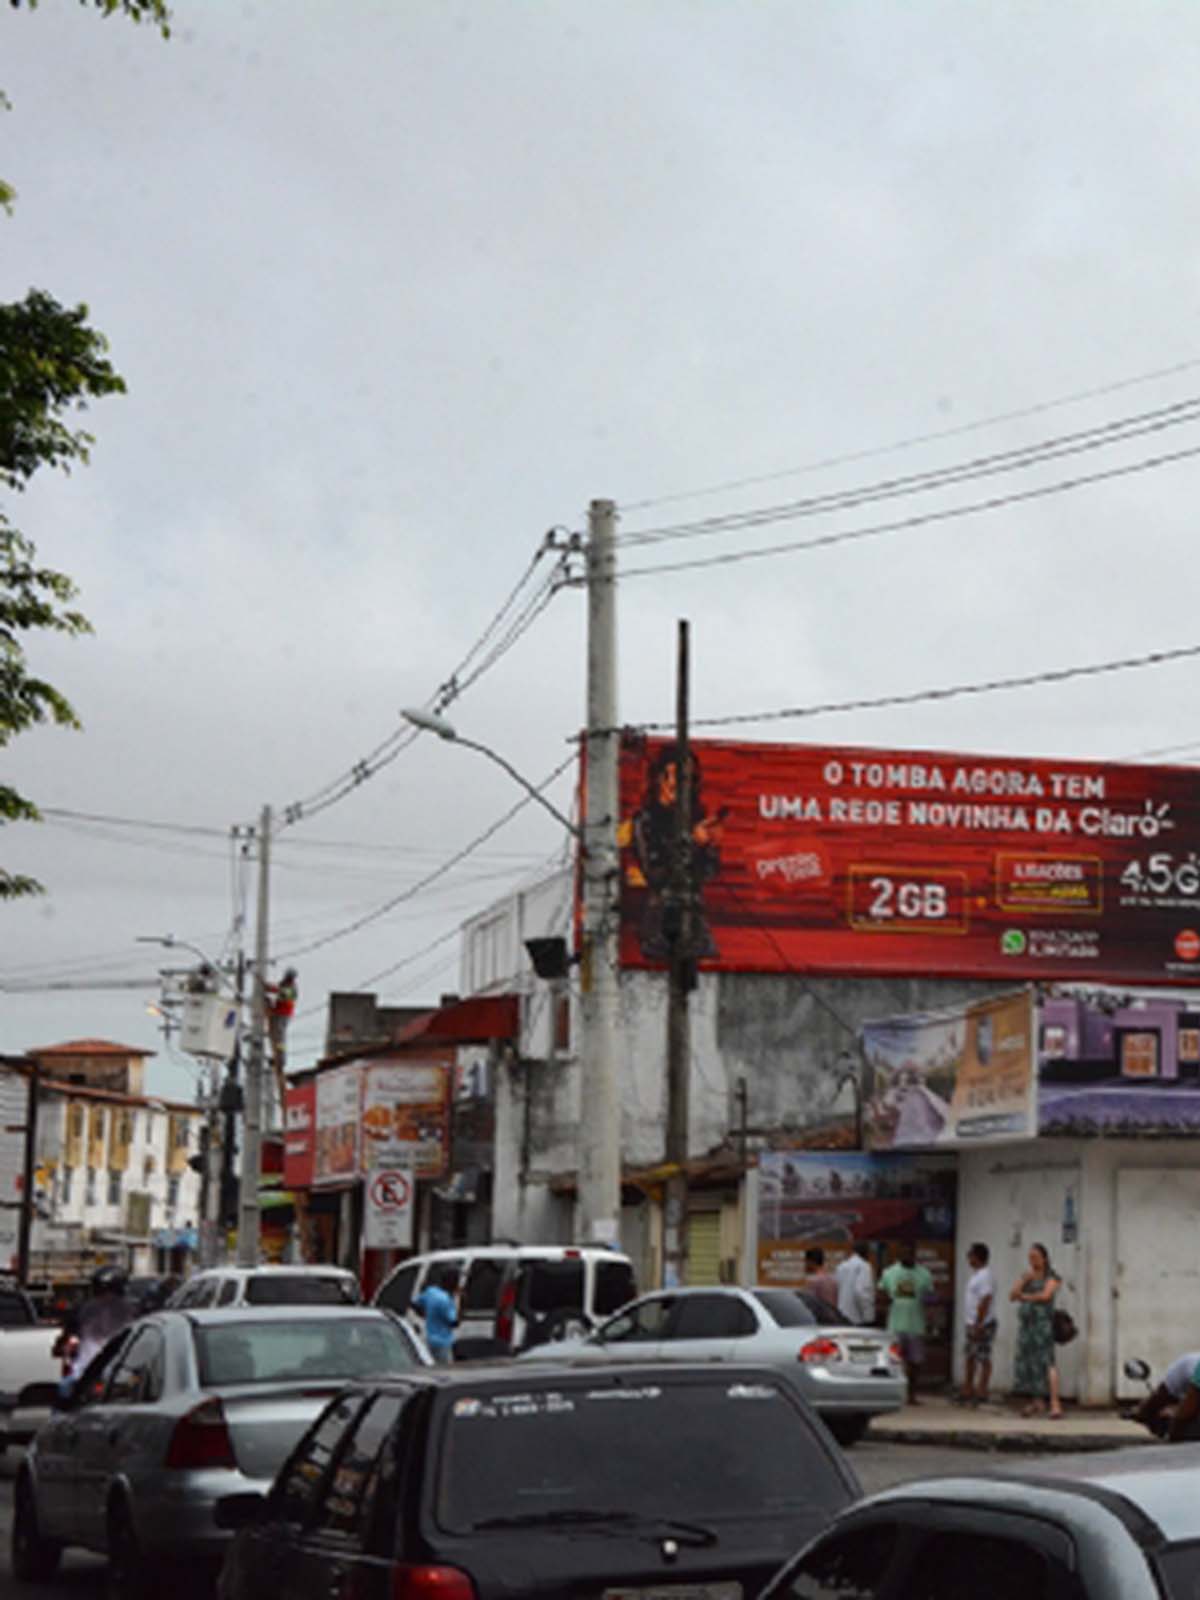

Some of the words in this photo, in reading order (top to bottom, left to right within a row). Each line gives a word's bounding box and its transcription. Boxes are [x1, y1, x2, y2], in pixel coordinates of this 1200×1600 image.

[823, 761, 844, 785] O
[851, 763, 946, 792] TOMBA
[952, 768, 1045, 796] AGORA
[1051, 774, 1105, 799] TEM
[759, 794, 822, 821] UMA
[829, 798, 902, 825] REDE
[908, 801, 1030, 831] NOVINHA
[1035, 807, 1072, 832] DA
[1079, 805, 1162, 838] Claro
[1120, 853, 1200, 894] 4.5G
